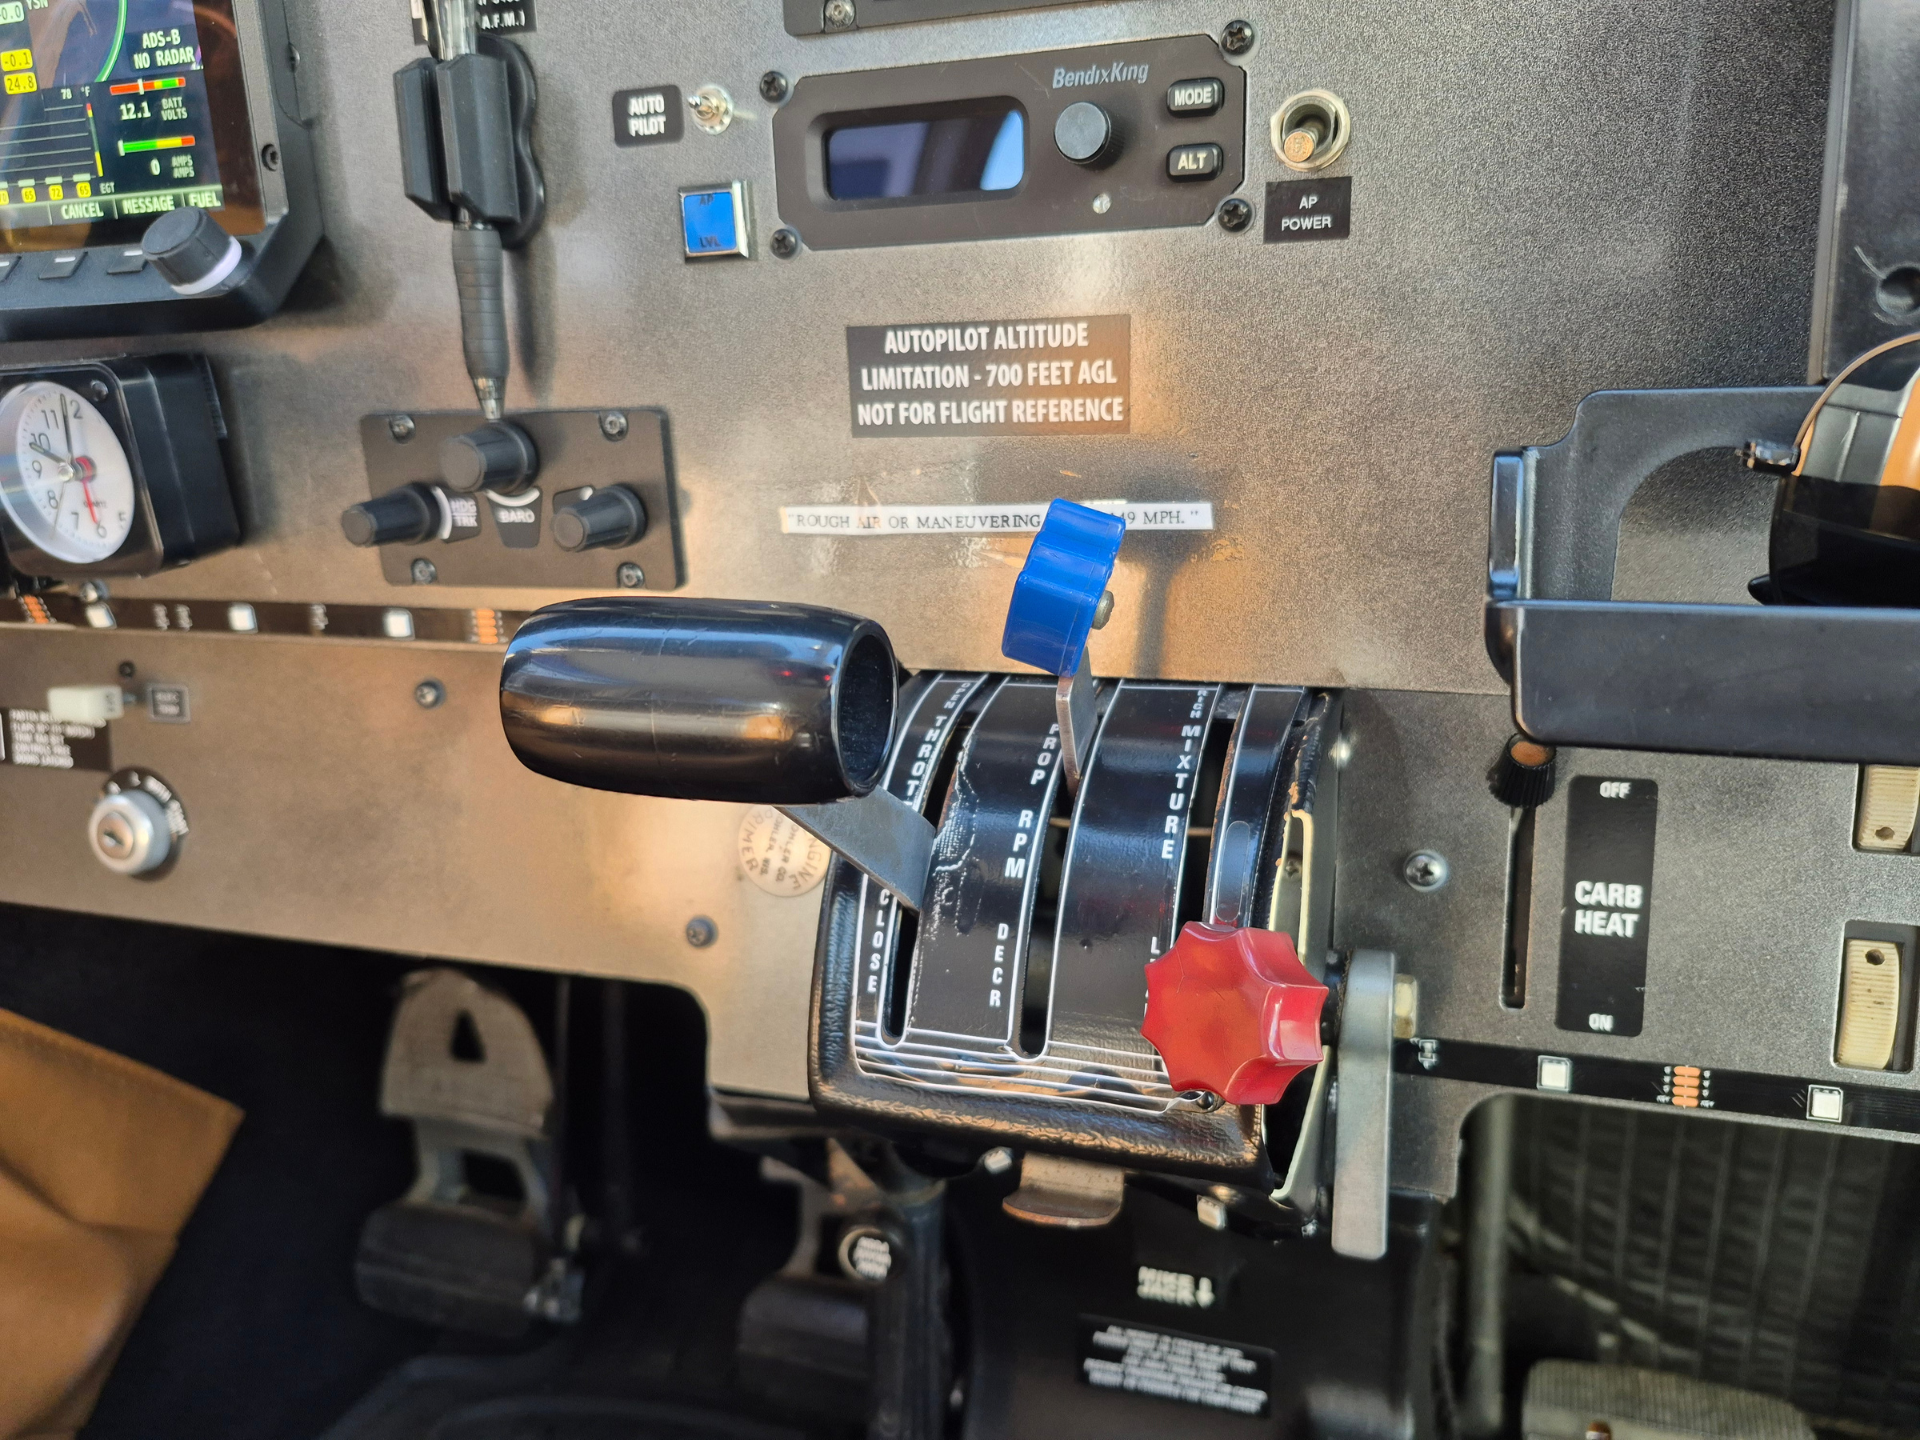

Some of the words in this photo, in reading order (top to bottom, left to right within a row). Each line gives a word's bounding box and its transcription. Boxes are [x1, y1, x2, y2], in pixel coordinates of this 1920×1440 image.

[0, 4, 21, 21] 0.0
[480, 9, 526, 31] A.F.M.)
[142, 29, 181, 49] ADS-B
[4, 52, 31, 68] -0.1
[133, 51, 151, 70] NO
[155, 46, 196, 66] RADAR
[6, 75, 35, 92] 24.8
[1052, 62, 1149, 90] BendixKing
[161, 97, 183, 110] BATT
[628, 93, 665, 116] AUTO
[1174, 86, 1213, 106] MODE
[120, 101, 151, 120] 12.1
[161, 108, 187, 121] VOLTS
[628, 113, 667, 137] PILOT
[151, 158, 160, 175] 0
[171, 155, 193, 167] AMPS
[1177, 153, 1208, 171] ALT
[173, 167, 195, 179] AMPS
[51, 188, 61, 198] 72
[100, 182, 115, 194] EGT
[61, 202, 104, 219] CANCEL
[122, 196, 175, 214] MESSAGE
[189, 192, 221, 207] FUEL
[1299, 195, 1318, 210] AP
[1281, 215, 1332, 231] POWER
[884, 326, 990, 354] AUTOPILOT
[994, 322, 1089, 350] ALTITUDE
[861, 365, 969, 391] LIMITATION
[985, 364, 1023, 387] 700
[1027, 360, 1074, 386] FEET
[1077, 359, 1117, 384] AGL
[41, 409, 59, 430] 11
[857, 402, 895, 426] NOT
[899, 401, 936, 425] FOR
[940, 400, 1007, 424] FLIGHT
[1011, 397, 1124, 424] REFERENCE
[32, 460, 42, 479] 9
[48, 490, 58, 509] 8
[449, 498, 477, 513] HDG
[71, 511, 79, 530] 7
[453, 515, 478, 527] TRK
[496, 507, 535, 523] BARO
[856, 515, 882, 529] AIR
[889, 516, 909, 529] OR
[917, 514, 1041, 529] MANEUVERING
[944, 682, 971, 709] OPEN
[903, 716, 947, 805] THROT
[1030, 723, 1060, 785] PROP
[1161, 725, 1200, 859] MIXTURE
[1599, 781, 1631, 799] OFF
[782, 824, 799, 863] OHLER
[1004, 809, 1033, 879] RPM
[789, 838, 821, 890] NGINE
[1574, 880, 1644, 909] CARB
[1574, 909, 1640, 938] HEAT
[867, 888, 890, 993] CLOSE
[989, 923, 1009, 1007] DECR
[1588, 1012, 1613, 1031] ON
